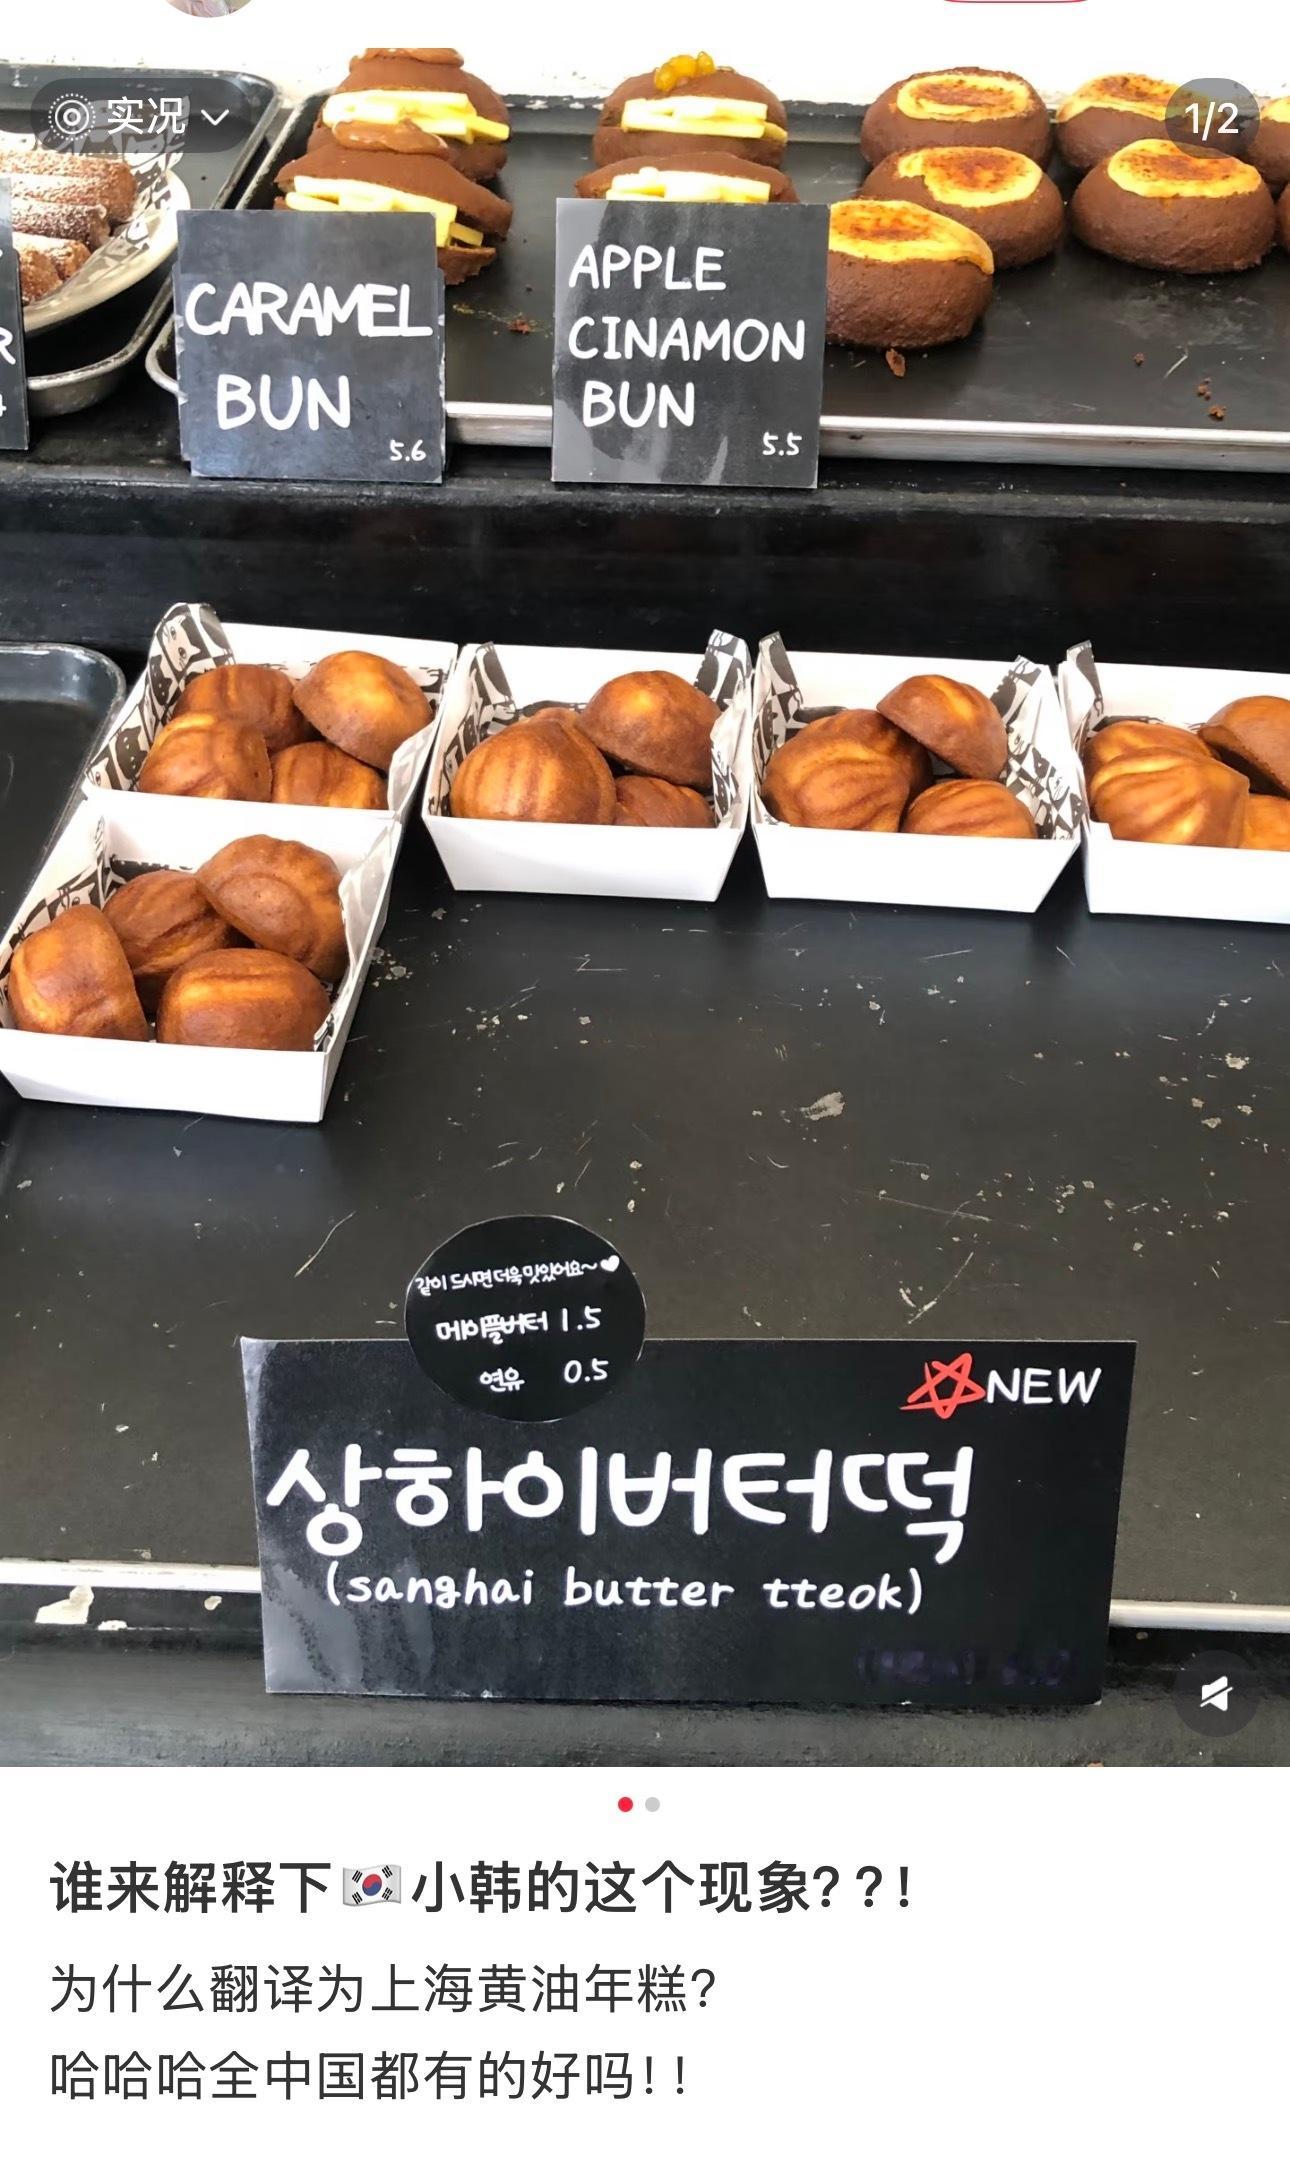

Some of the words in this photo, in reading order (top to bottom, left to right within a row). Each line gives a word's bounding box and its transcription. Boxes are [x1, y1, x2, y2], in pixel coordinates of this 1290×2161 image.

[568, 243, 727, 291] APPLE
[185, 281, 432, 337] CARAMEL
[568, 316, 806, 362] CINAMON
[216, 373, 351, 431] BUN
[582, 380, 695, 429] BUN
[389, 439, 428, 462] 5.6
[762, 431, 802, 456] 5.5
[415, 1274, 448, 1297] 같이
[435, 1310, 549, 1345] 메이플버터
[561, 1305, 602, 1332] 1.5
[479, 1366, 526, 1393] 연유
[563, 1357, 609, 1384] 0.5
[986, 1367, 1102, 1406] NEW
[265, 1443, 975, 1565] 상하이버터떡
[326, 1561, 534, 1610] (sanghai
[563, 1565, 735, 1608] butter
[762, 1567, 923, 1615] tteok)
